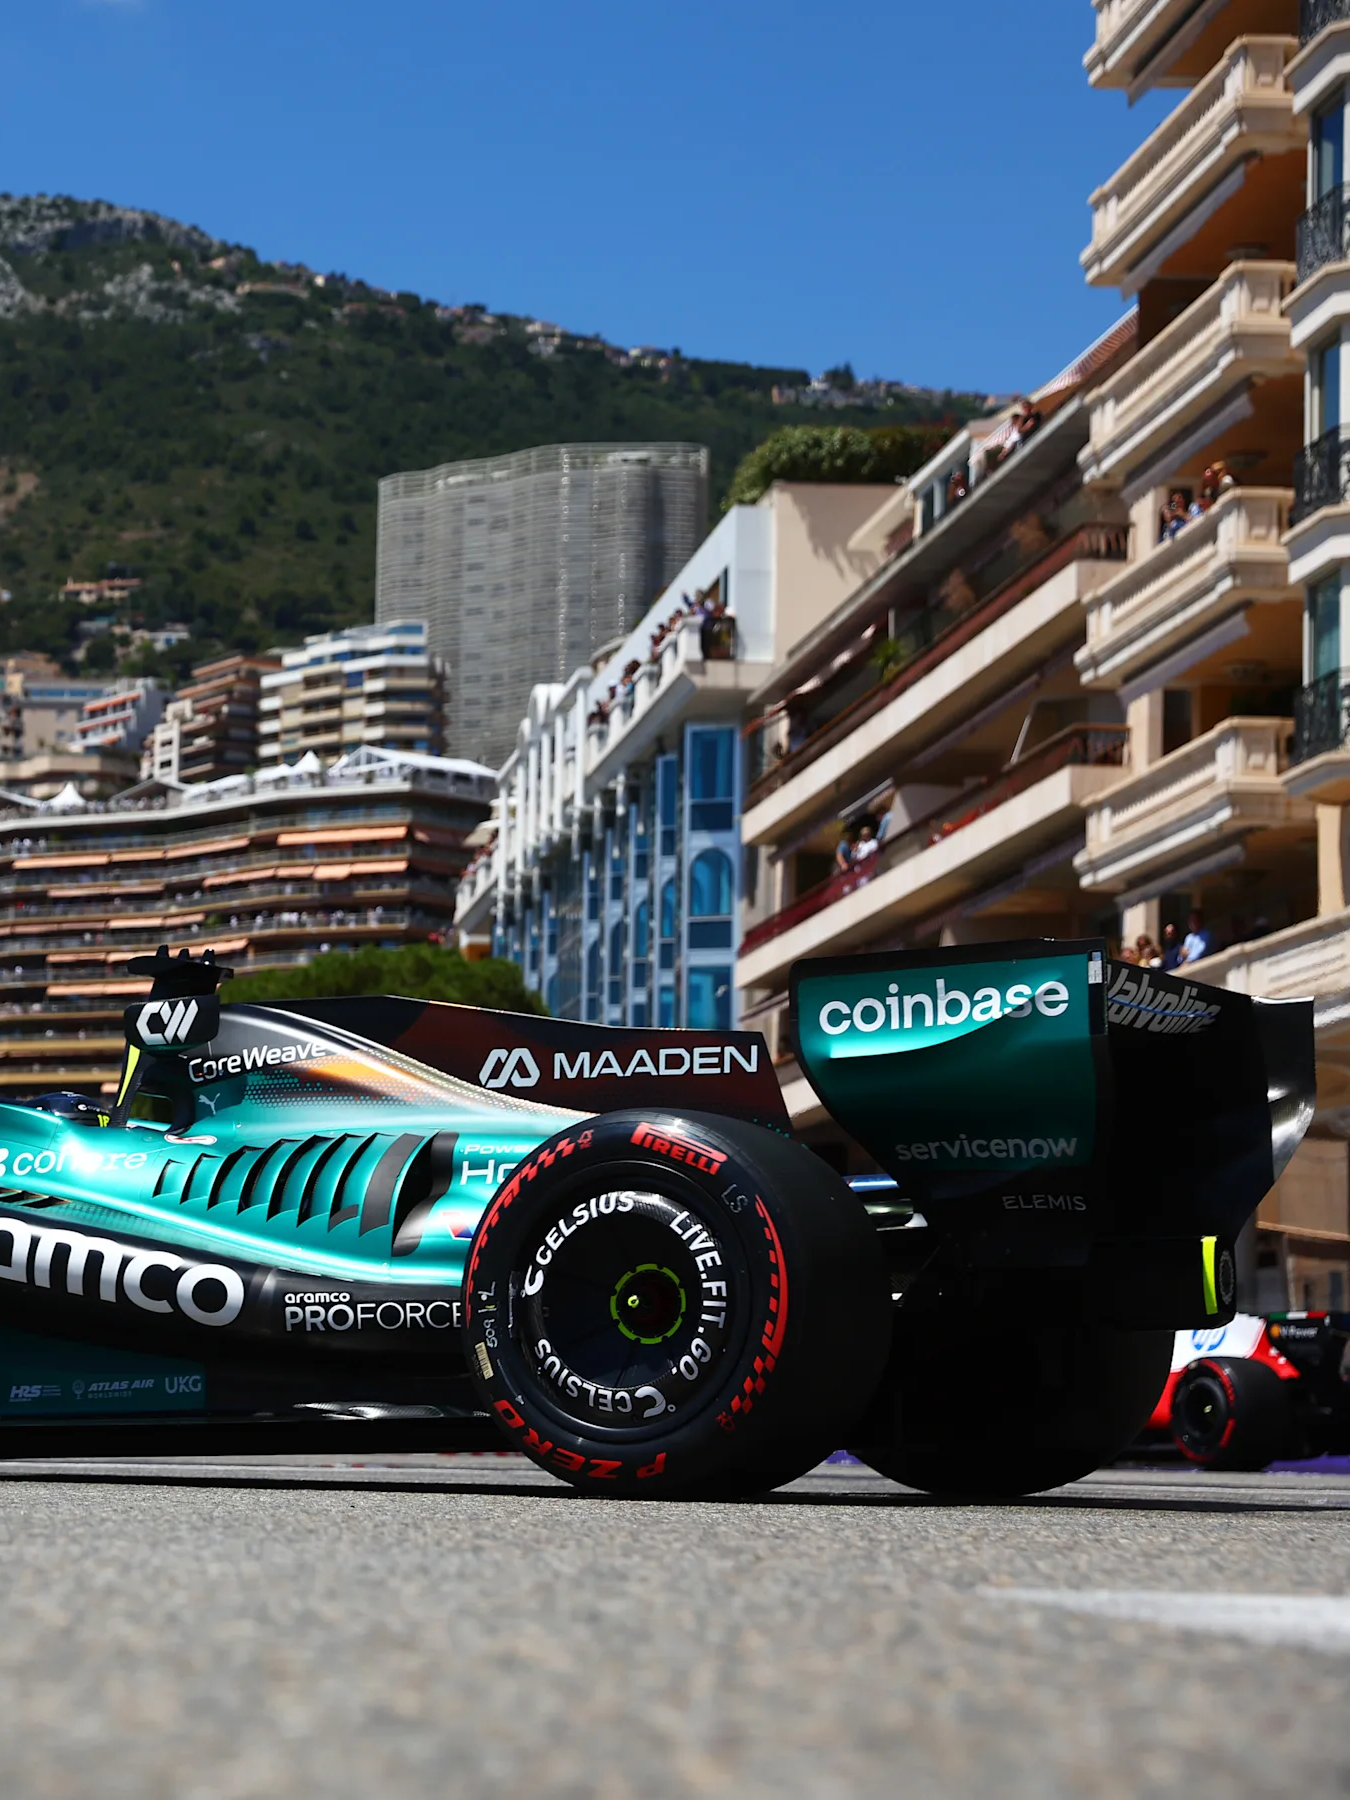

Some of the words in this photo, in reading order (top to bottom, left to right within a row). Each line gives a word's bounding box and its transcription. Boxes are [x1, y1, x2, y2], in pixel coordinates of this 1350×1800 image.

[818, 978, 1070, 1036] coinbase
[188, 1042, 327, 1083] CoreWeave
[553, 1044, 759, 1080] MAADEN
[629, 1121, 728, 1176] PIRELLI
[894, 1132, 1078, 1162] servicenow
[1002, 1193, 1087, 1212] ELEMIS
[535, 1190, 638, 1266] CELSIUS
[284, 1292, 351, 1304] aramco
[668, 1209, 728, 1382] LIVE.FIT.GO.
[284, 1301, 462, 1332] PROFORCE
[10, 1385, 43, 1398] HRS
[88, 1381, 130, 1392] ATLAS
[131, 1379, 155, 1389] AIR
[164, 1375, 202, 1394] UKG
[534, 1338, 633, 1413] CELSIUS
[493, 1398, 624, 1479] ZERO
